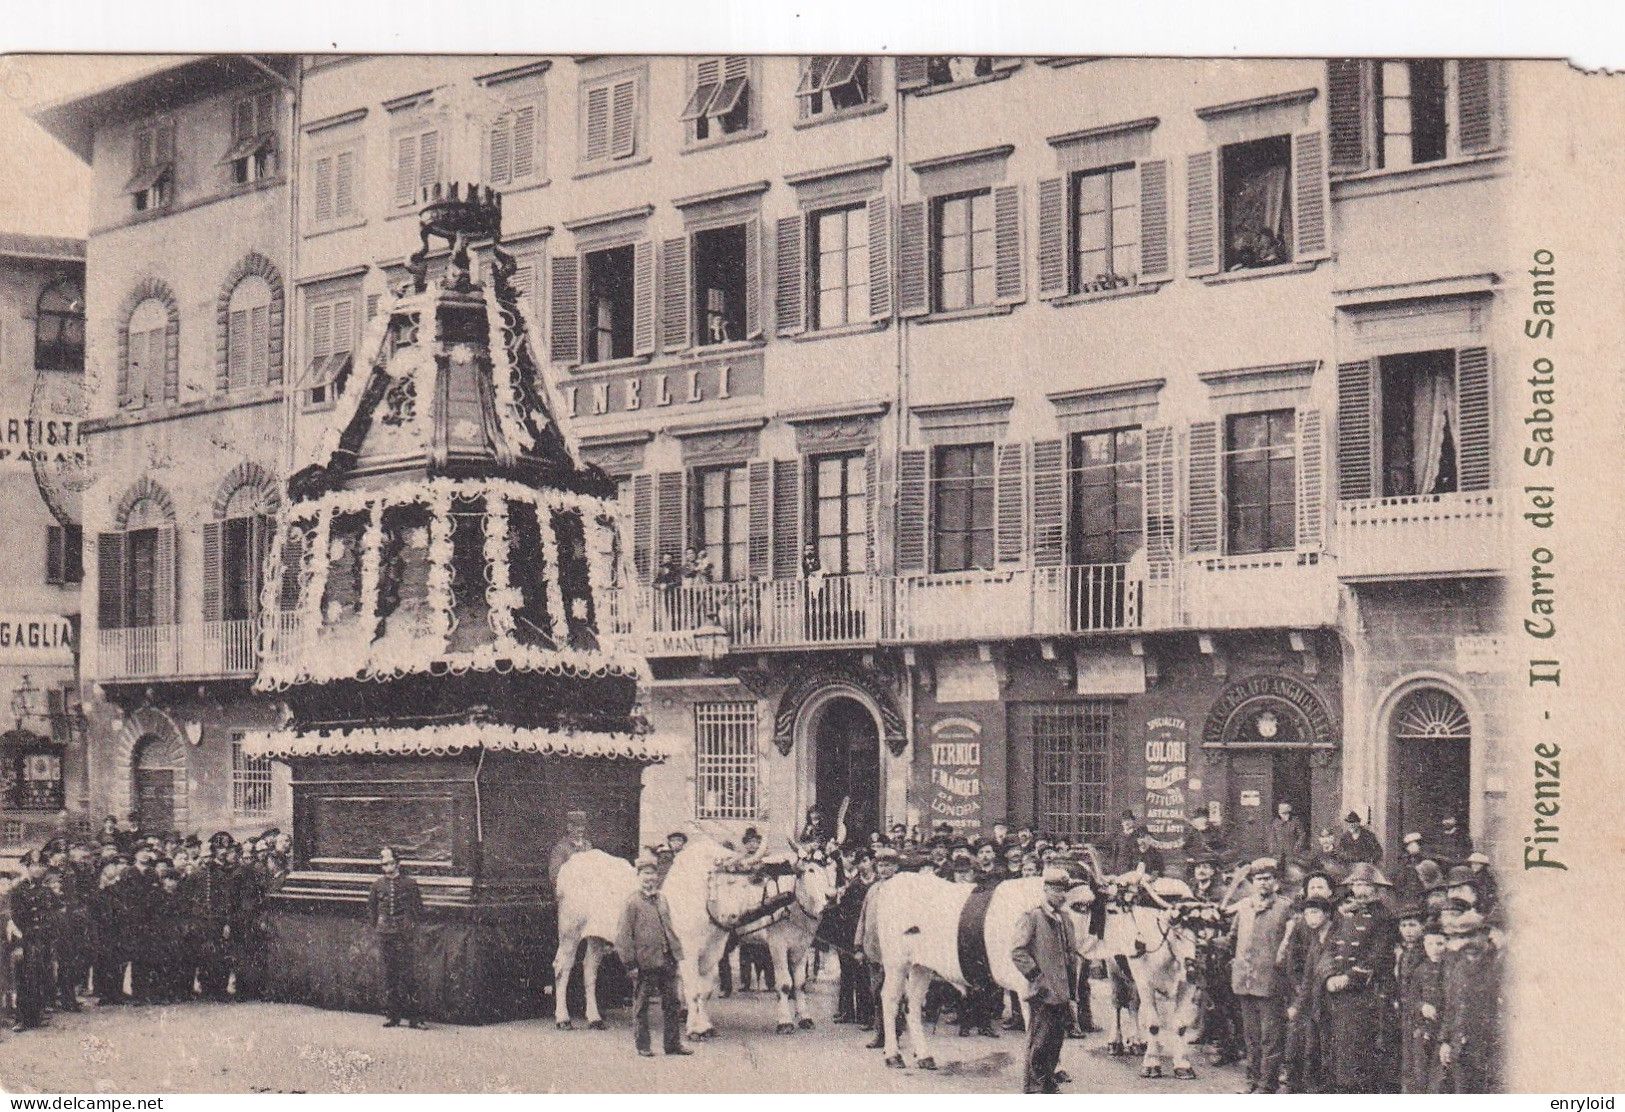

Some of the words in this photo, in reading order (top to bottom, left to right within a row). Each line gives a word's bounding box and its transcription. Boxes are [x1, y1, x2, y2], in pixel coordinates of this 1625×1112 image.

[0, 623, 71, 648] GAGLIA
[931, 743, 981, 766] VERNICI
[1145, 740, 1187, 763] COLORI
[931, 799, 981, 816] LONDRA
